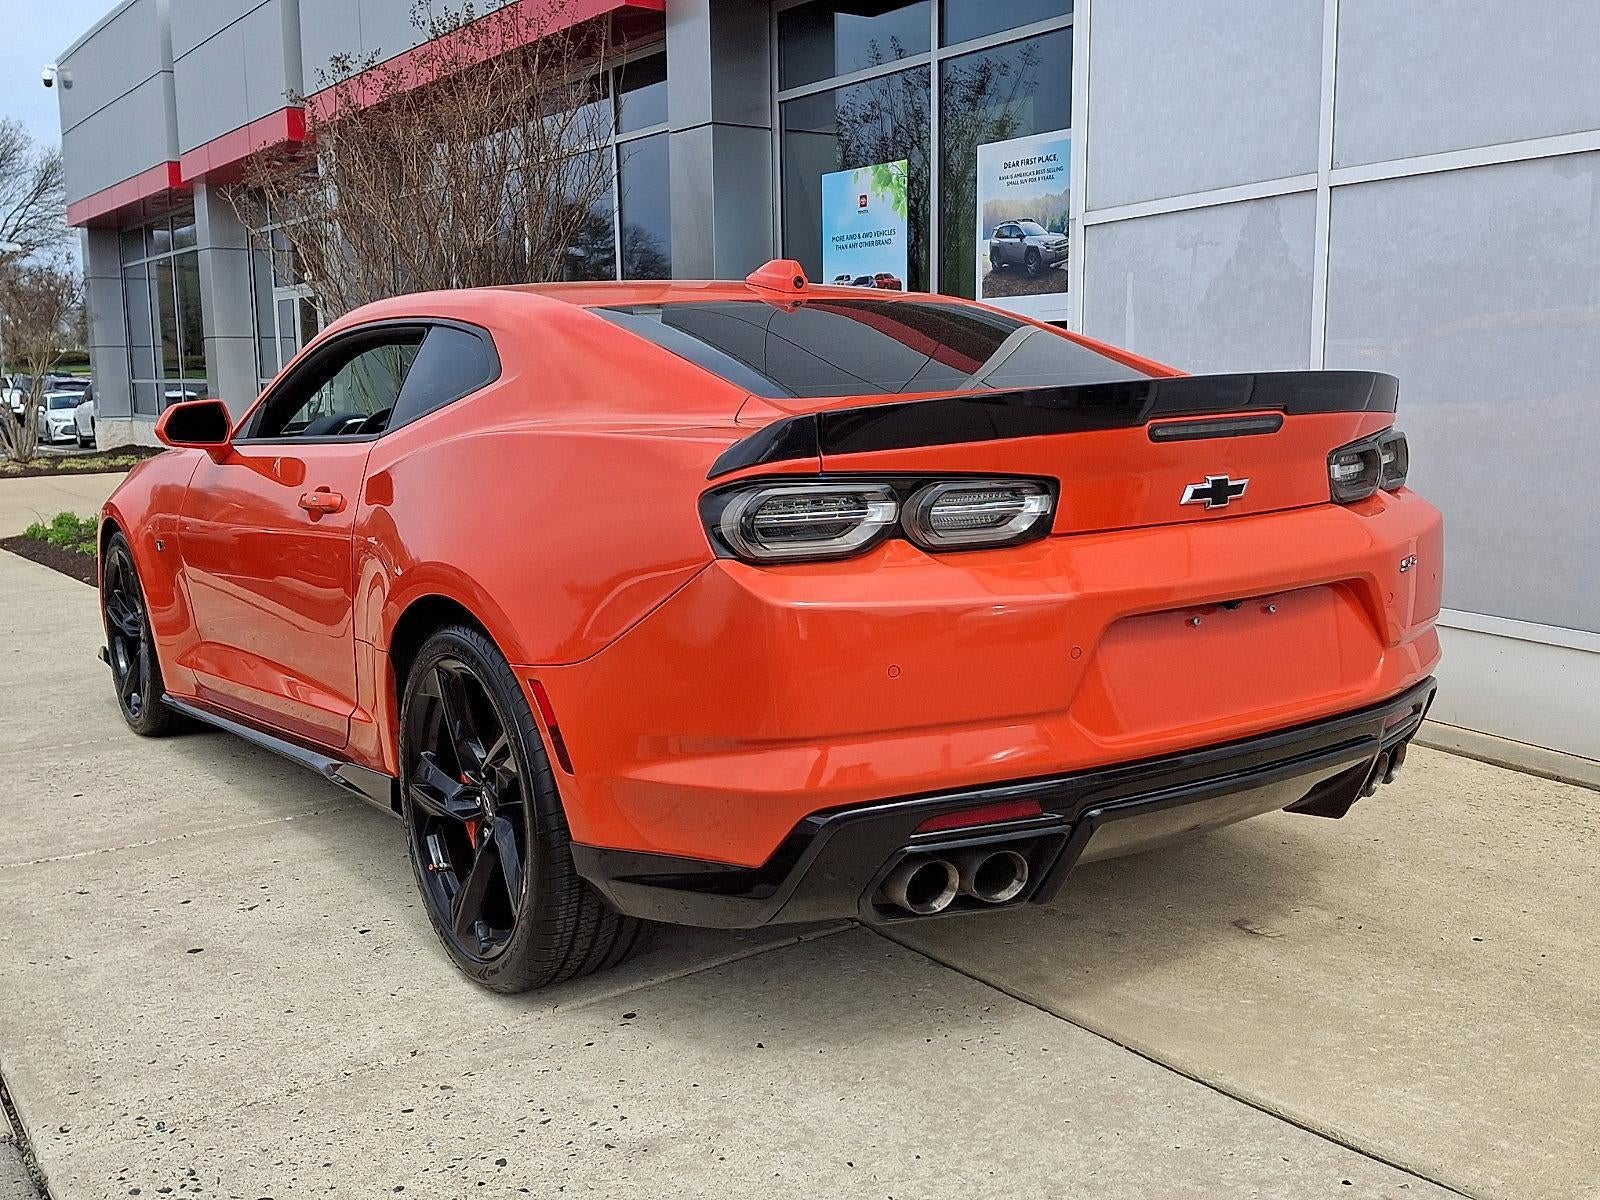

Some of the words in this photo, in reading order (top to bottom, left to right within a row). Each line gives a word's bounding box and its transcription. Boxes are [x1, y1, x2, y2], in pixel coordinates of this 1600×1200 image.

[1003, 160, 1020, 169] DEAR
[1020, 156, 1037, 166] FIRST
[1038, 153, 1059, 163] PLACE,
[832, 234, 845, 242] MORE
[873, 228, 896, 238] VEHICLES
[835, 243, 848, 251] THAN
[858, 240, 874, 248] OTHER
